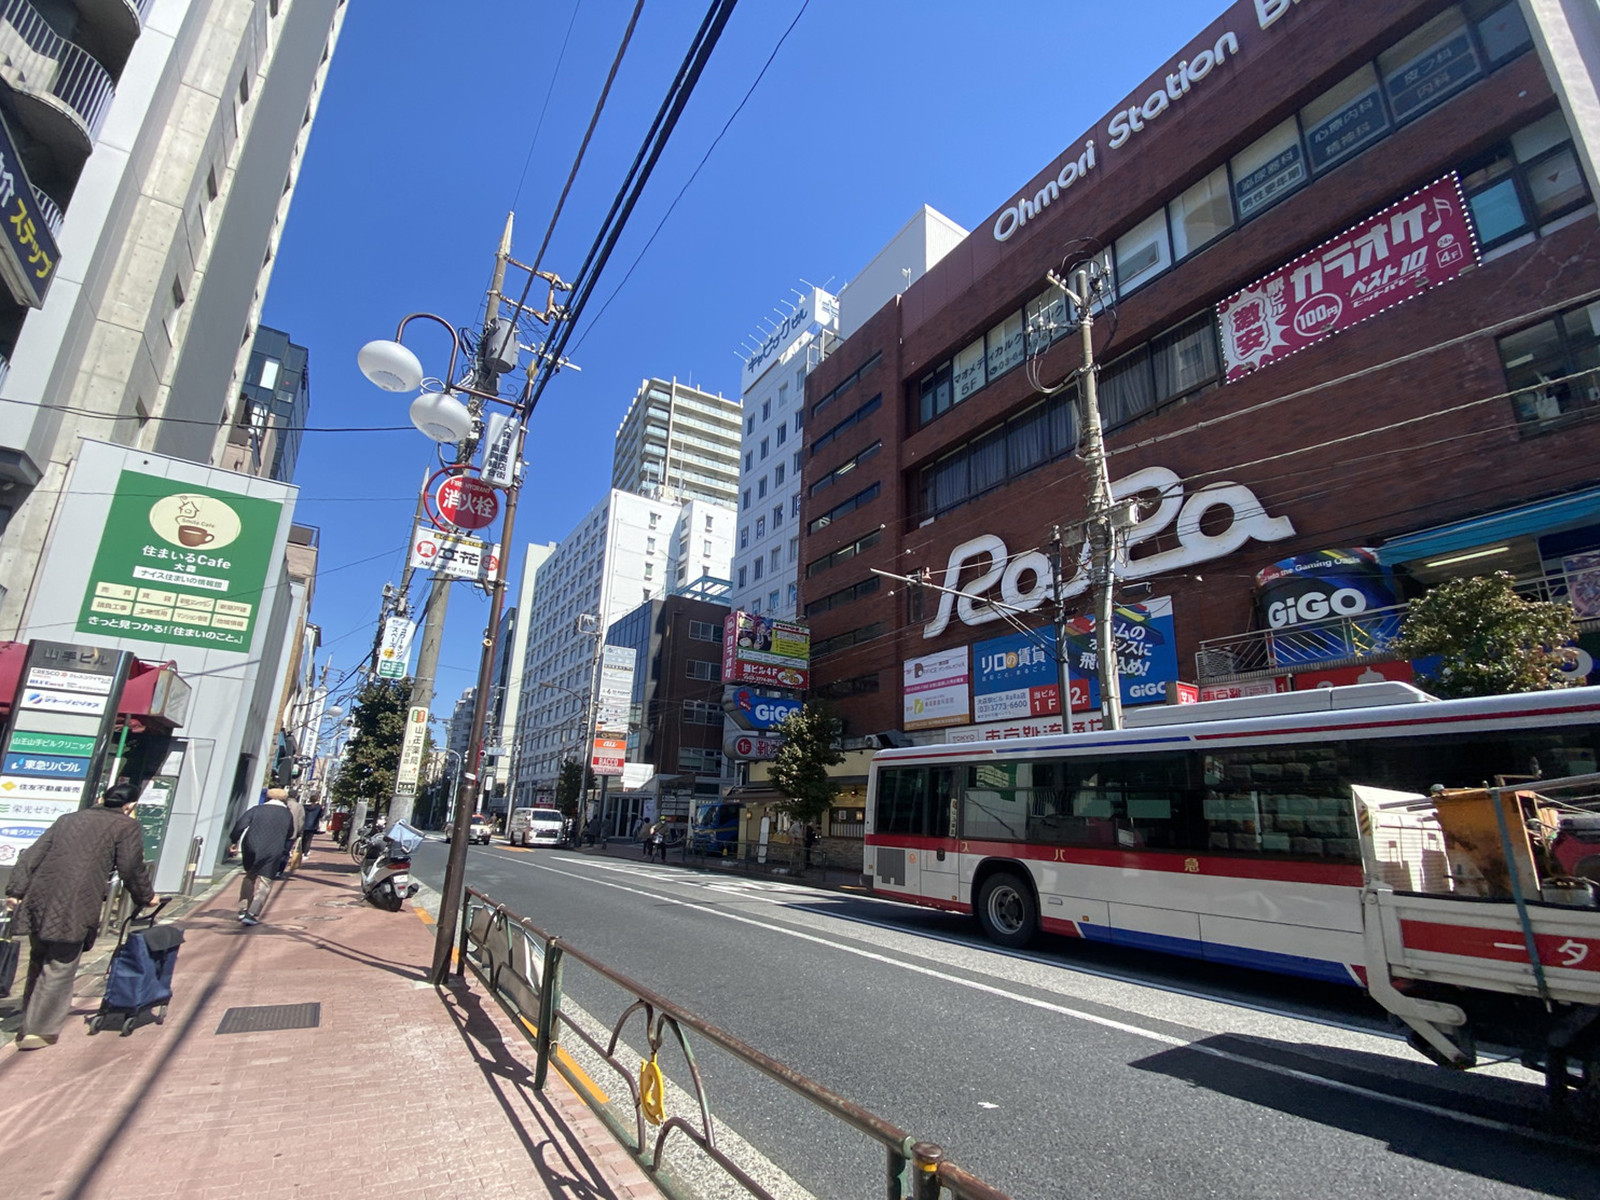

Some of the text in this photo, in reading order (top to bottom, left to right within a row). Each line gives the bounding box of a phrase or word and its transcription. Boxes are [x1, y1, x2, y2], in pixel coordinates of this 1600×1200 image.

[994, 140, 1096, 241] Ohmori
[1108, 31, 1239, 150] Station
[10, 197, 52, 278] ステップ
[1290, 203, 1427, 303] カラオケ
[1441, 250, 1459, 262] 4F
[1266, 276, 1287, 318] 駅ビル
[1232, 301, 1264, 356] 激安
[1298, 304, 1339, 331] 100円
[961, 376, 977, 395] 5F
[464, 482, 491, 494] HYDRANT
[442, 487, 495, 518] 消火栓
[1295, 560, 1333, 572] Gaming
[1268, 587, 1367, 630] GiGO
[45, 647, 108, 665] 山手ビル
[725, 635, 734, 679] カラオケ
[981, 643, 1046, 674] リロの賃貸
[12, 738, 94, 750] 山王山手ビルクリニック
[740, 741, 751, 753] 1F
[24, 759, 81, 773] 東急リバブル
[20, 783, 80, 794] 住友不動産販売
[1184, 857, 1200, 873] 急
